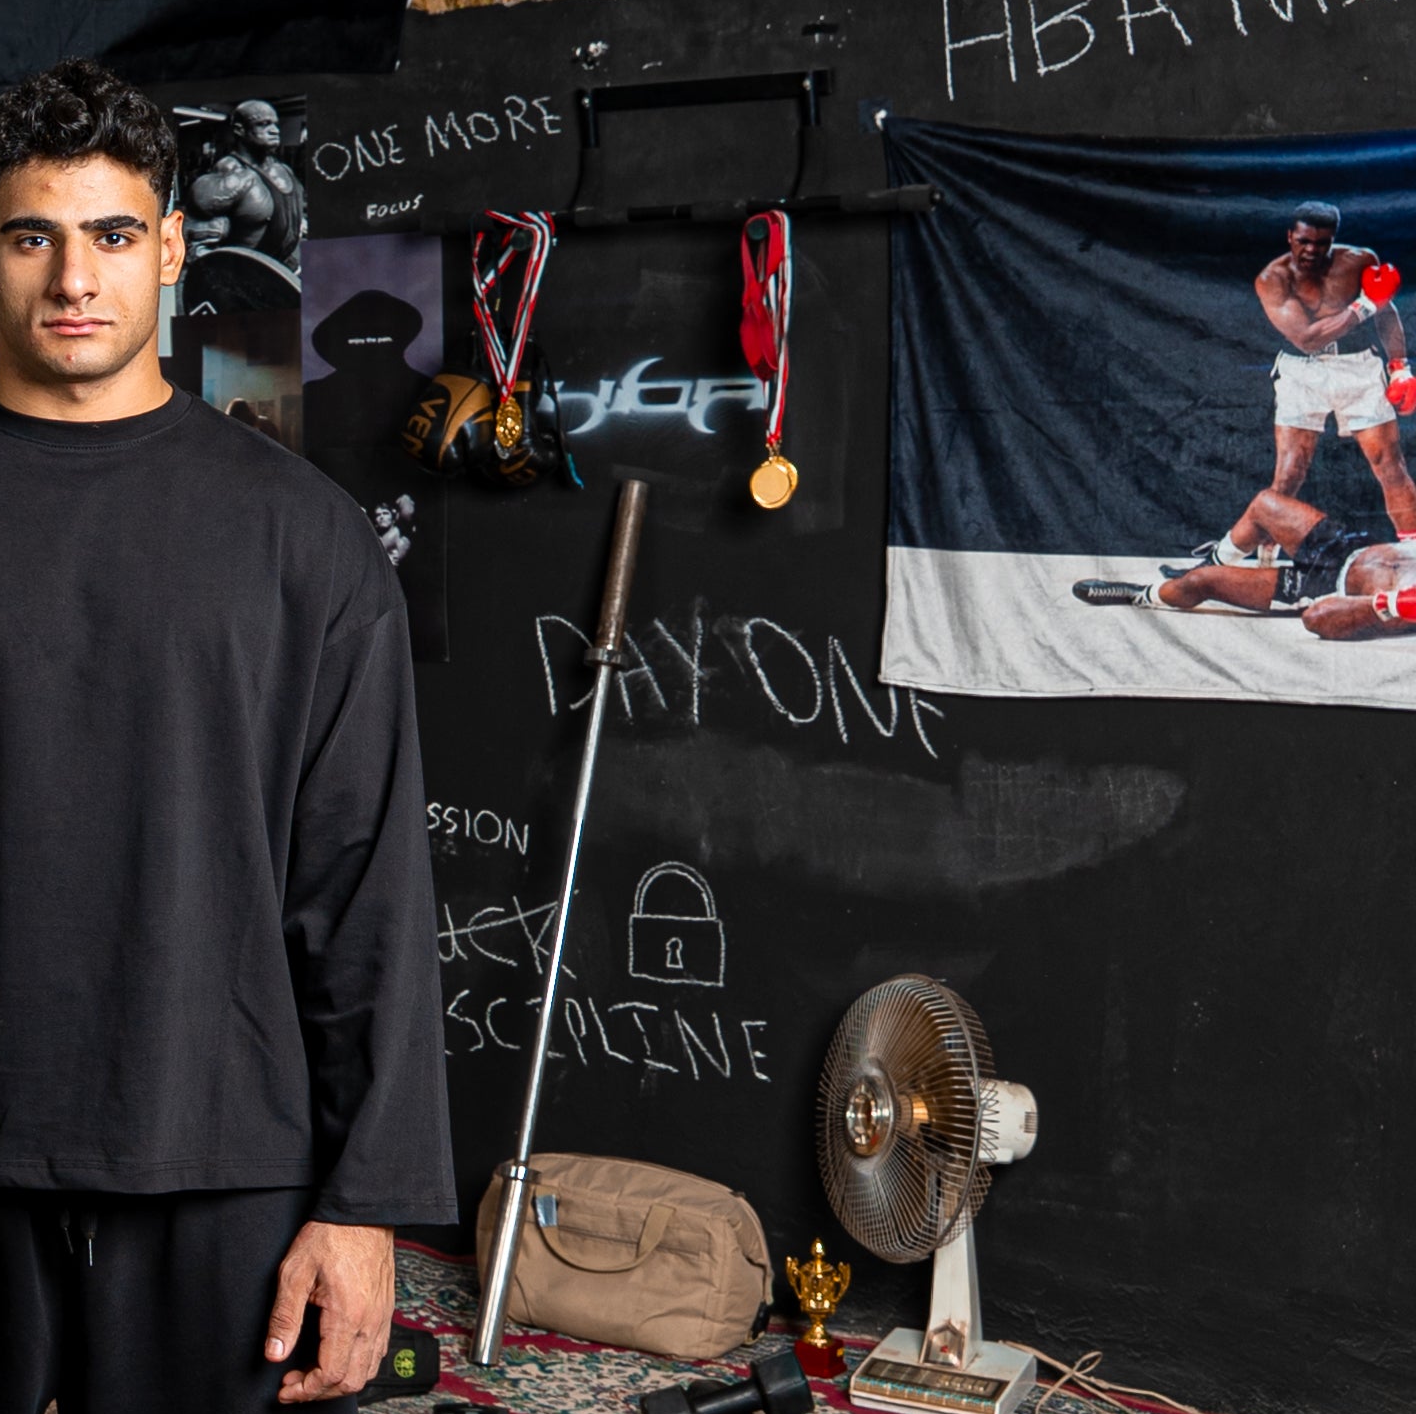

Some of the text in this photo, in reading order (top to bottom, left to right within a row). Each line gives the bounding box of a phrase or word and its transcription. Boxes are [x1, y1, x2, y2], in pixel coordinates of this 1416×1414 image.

[312, 95, 562, 181] ONE MORE
[366, 193, 425, 220] FOCUS
[536, 615, 703, 725] DAY
[445, 990, 772, 1082] SCPLINE
